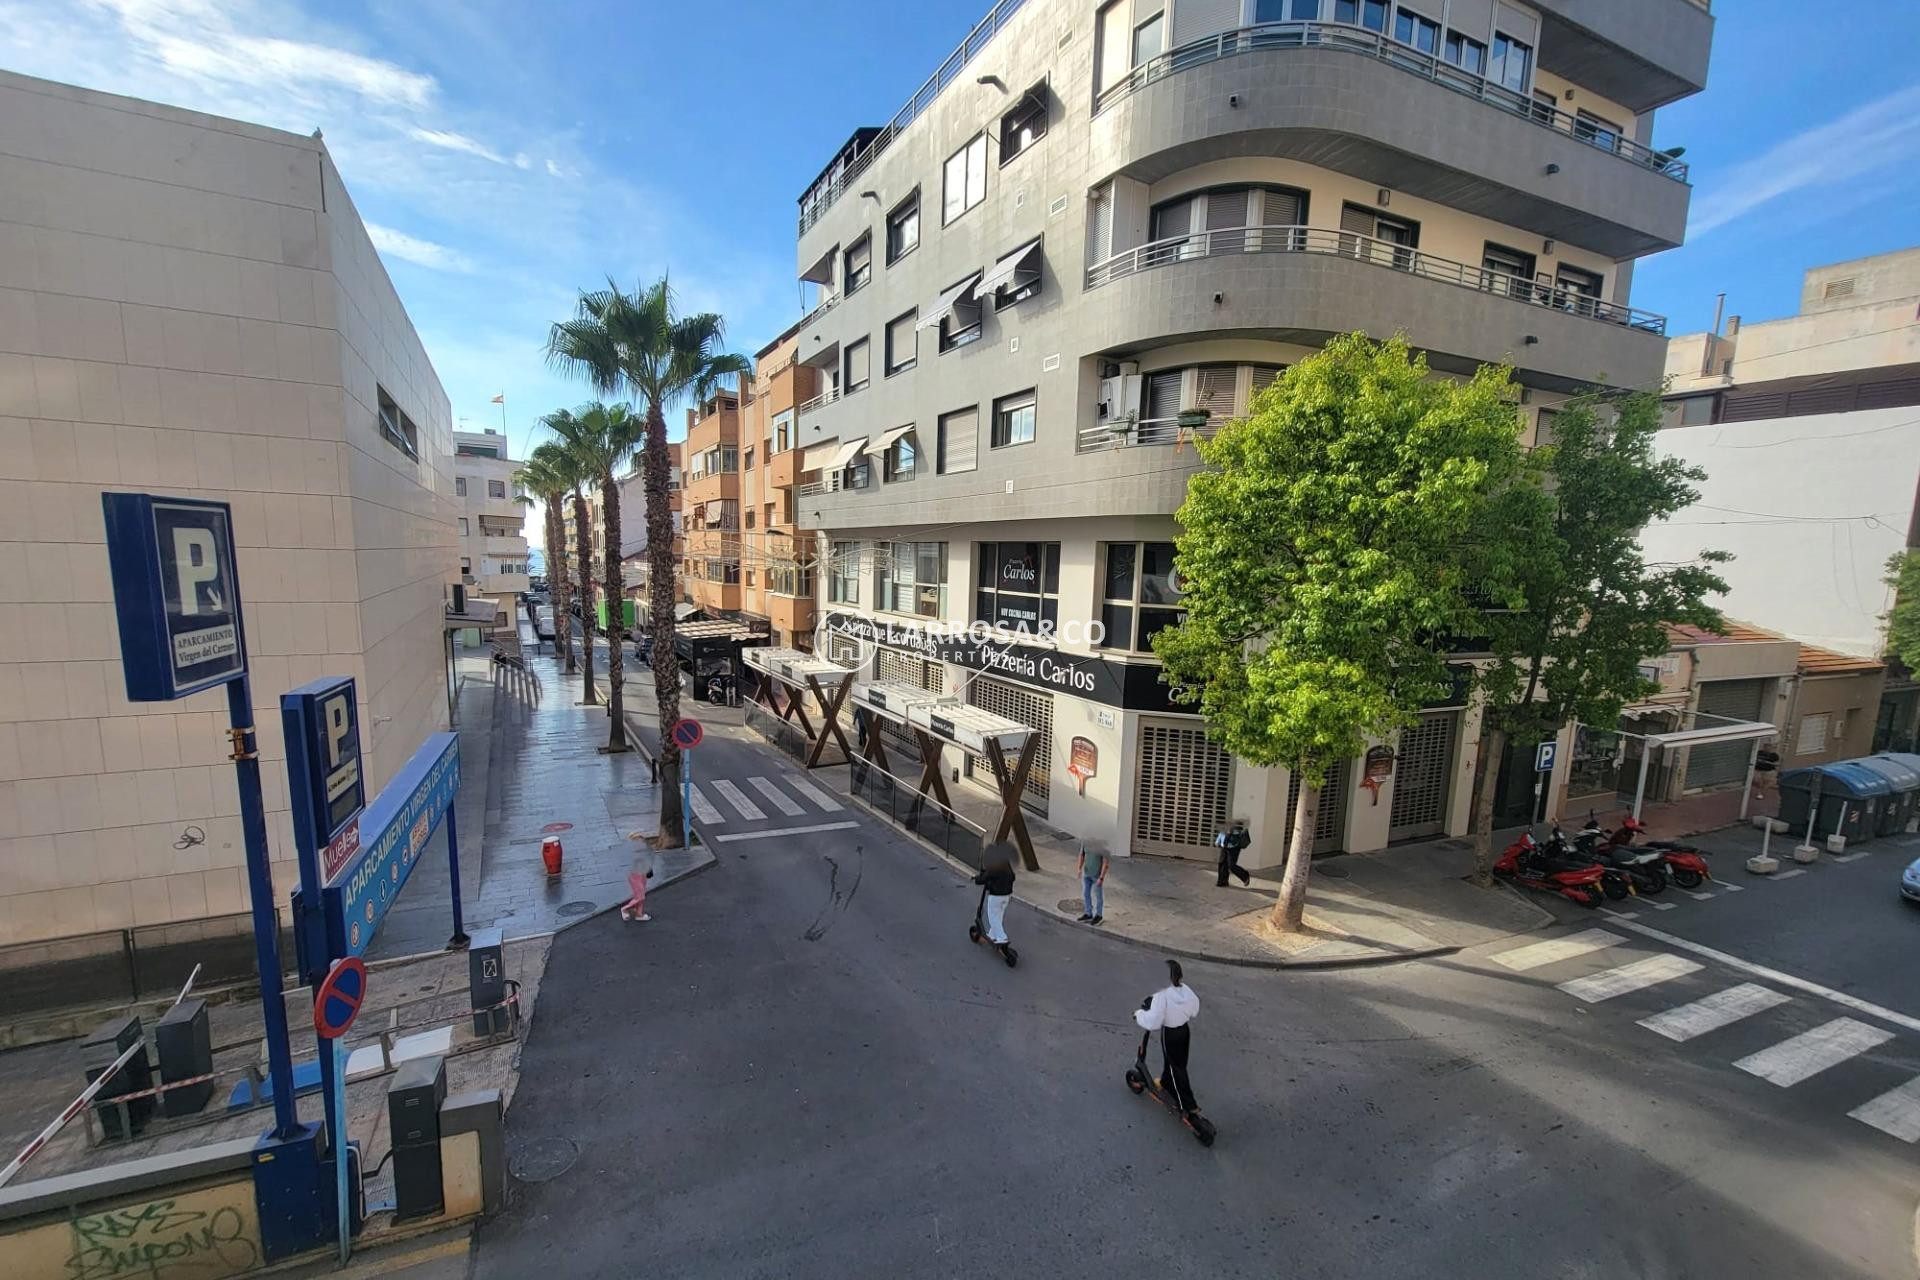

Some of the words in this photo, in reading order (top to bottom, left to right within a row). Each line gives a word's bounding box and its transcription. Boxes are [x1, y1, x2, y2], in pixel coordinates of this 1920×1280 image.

[172, 528, 218, 616] P
[1003, 564, 1035, 580] Carlos
[178, 629, 233, 649] APARCAMIENTO
[179, 650, 201, 664] Virgen
[202, 645, 212, 656] del
[1040, 657, 1095, 692] Carlos
[324, 694, 349, 769] P
[1541, 746, 1553, 768] P
[346, 808, 410, 912] APARCAMIENTO
[410, 776, 432, 817] VIRGEN
